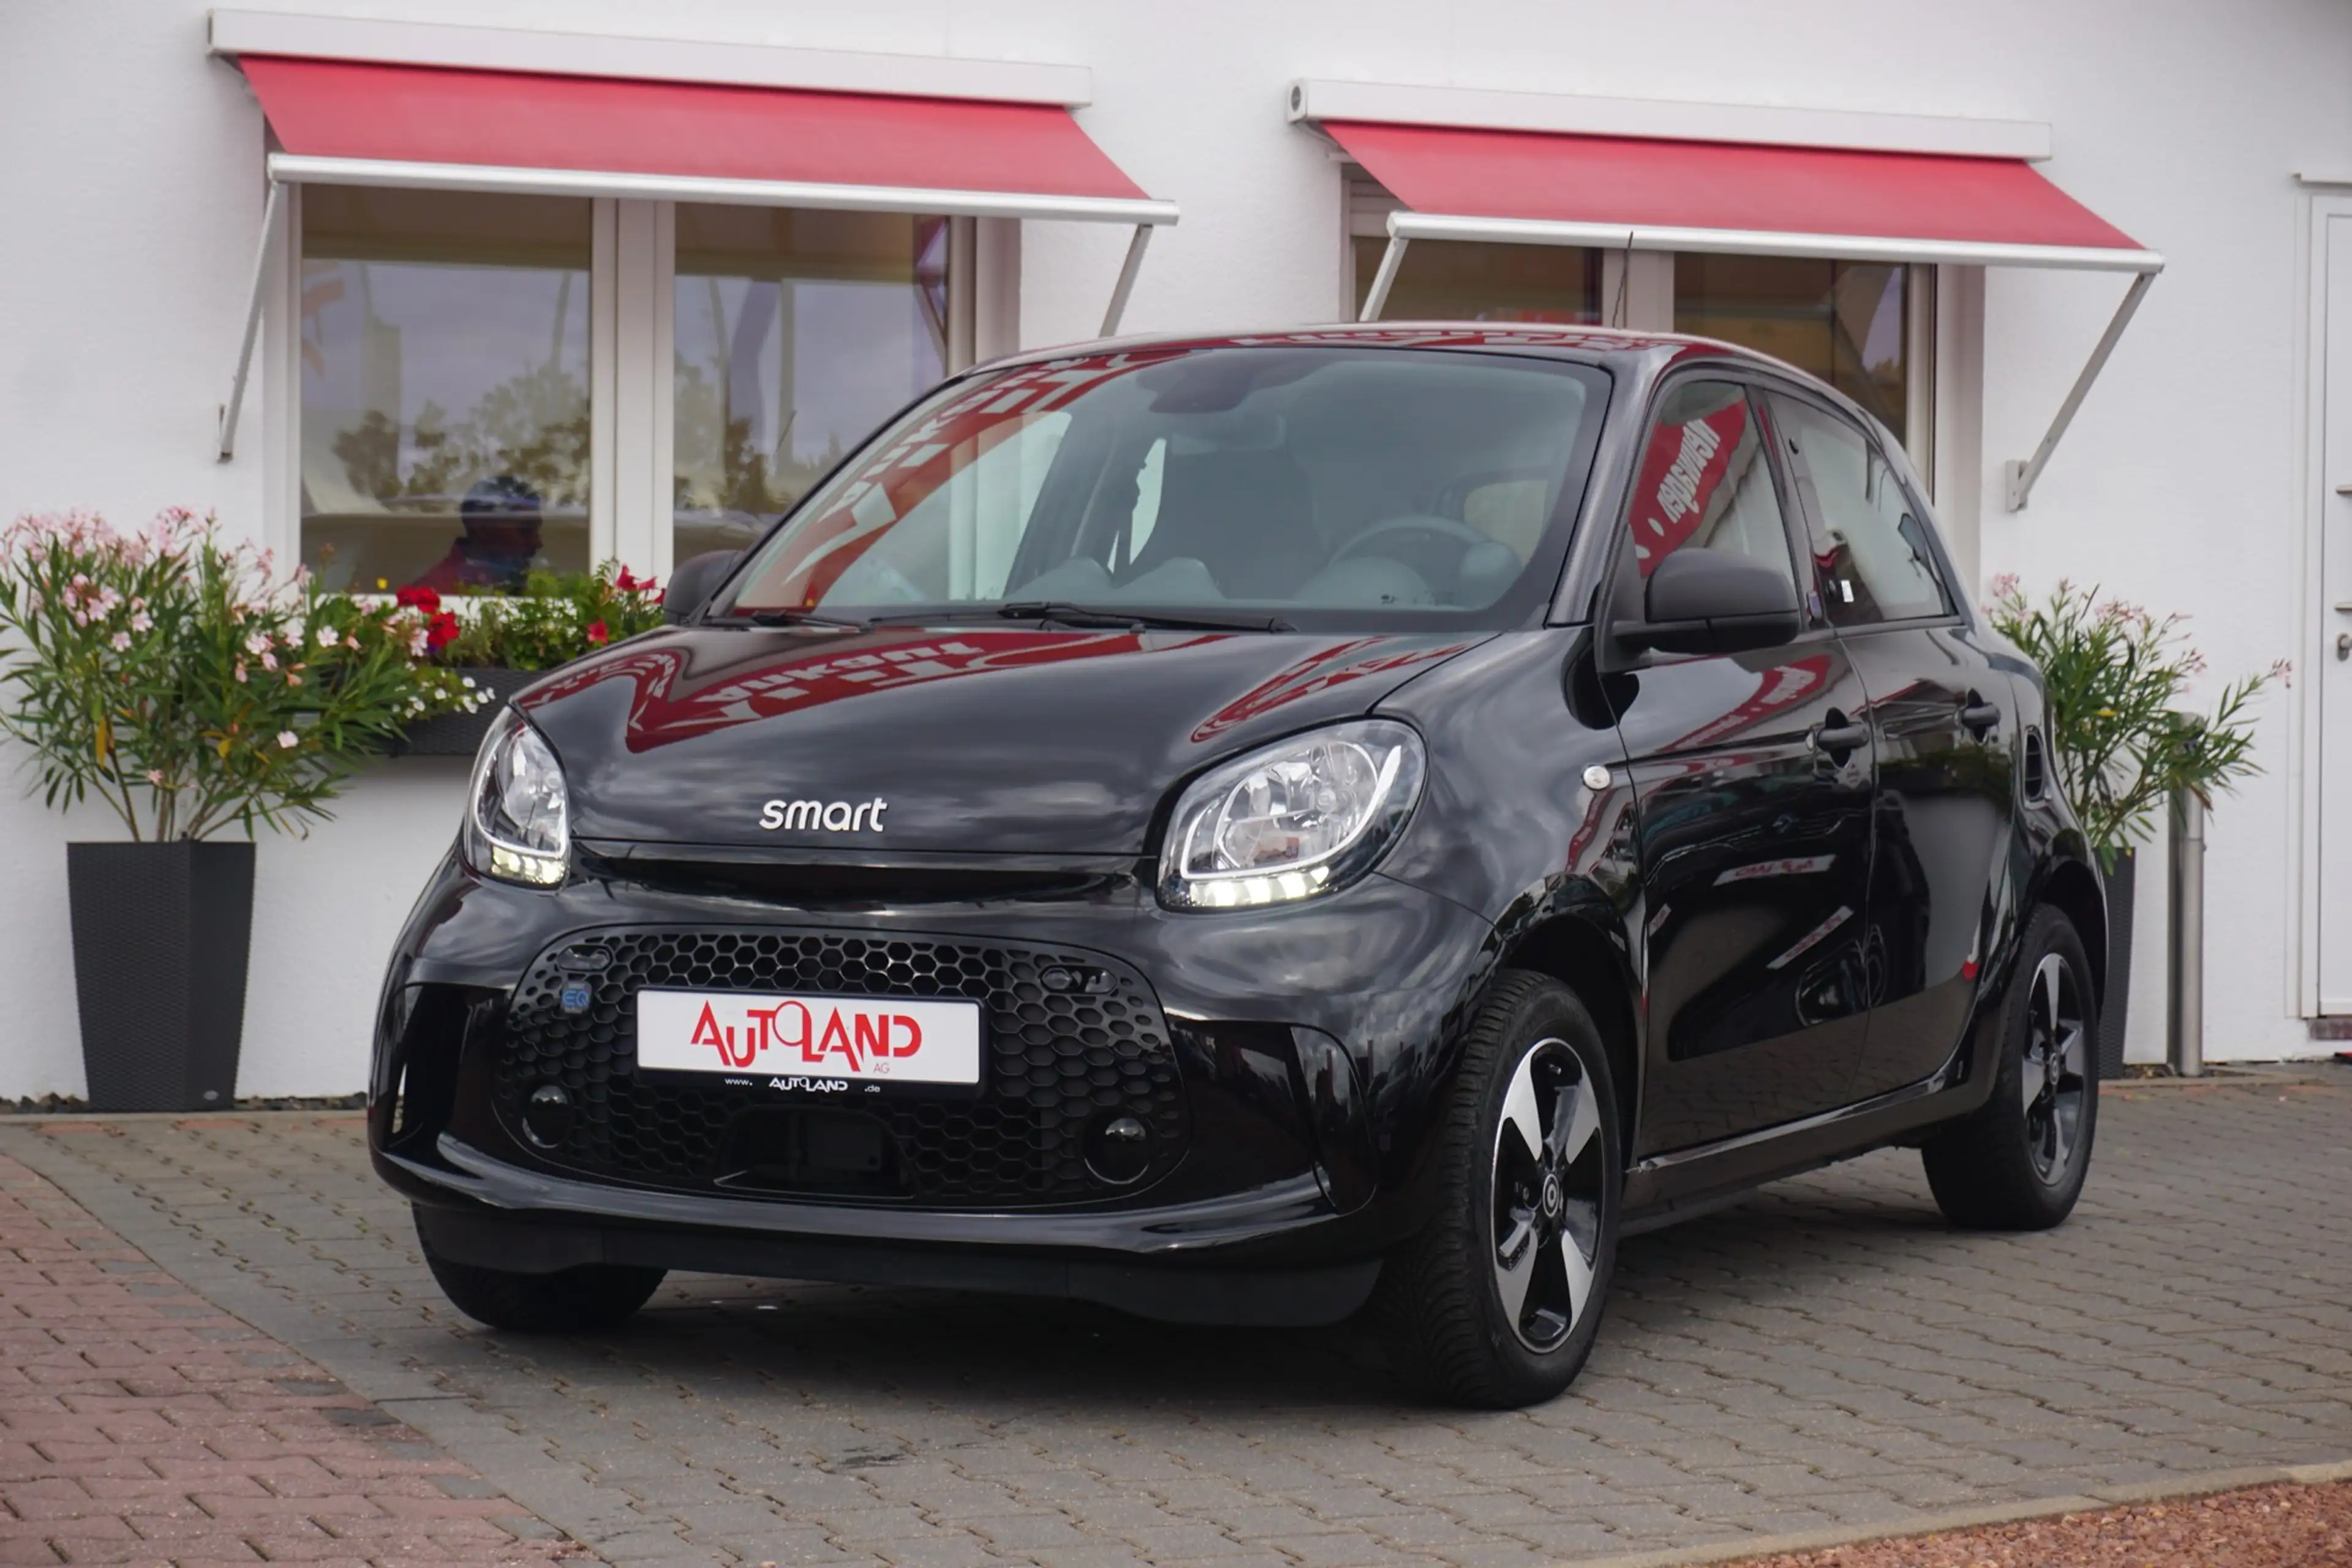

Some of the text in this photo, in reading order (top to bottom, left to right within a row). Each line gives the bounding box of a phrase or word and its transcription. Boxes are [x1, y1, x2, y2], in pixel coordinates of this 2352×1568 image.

[759, 797, 888, 832] smart
[562, 990, 589, 1007] EQ
[690, 1000, 922, 1072] AUTOLAND
[873, 1063, 890, 1074] AG
[725, 1077, 881, 1093] www. AUTOLAND .de
